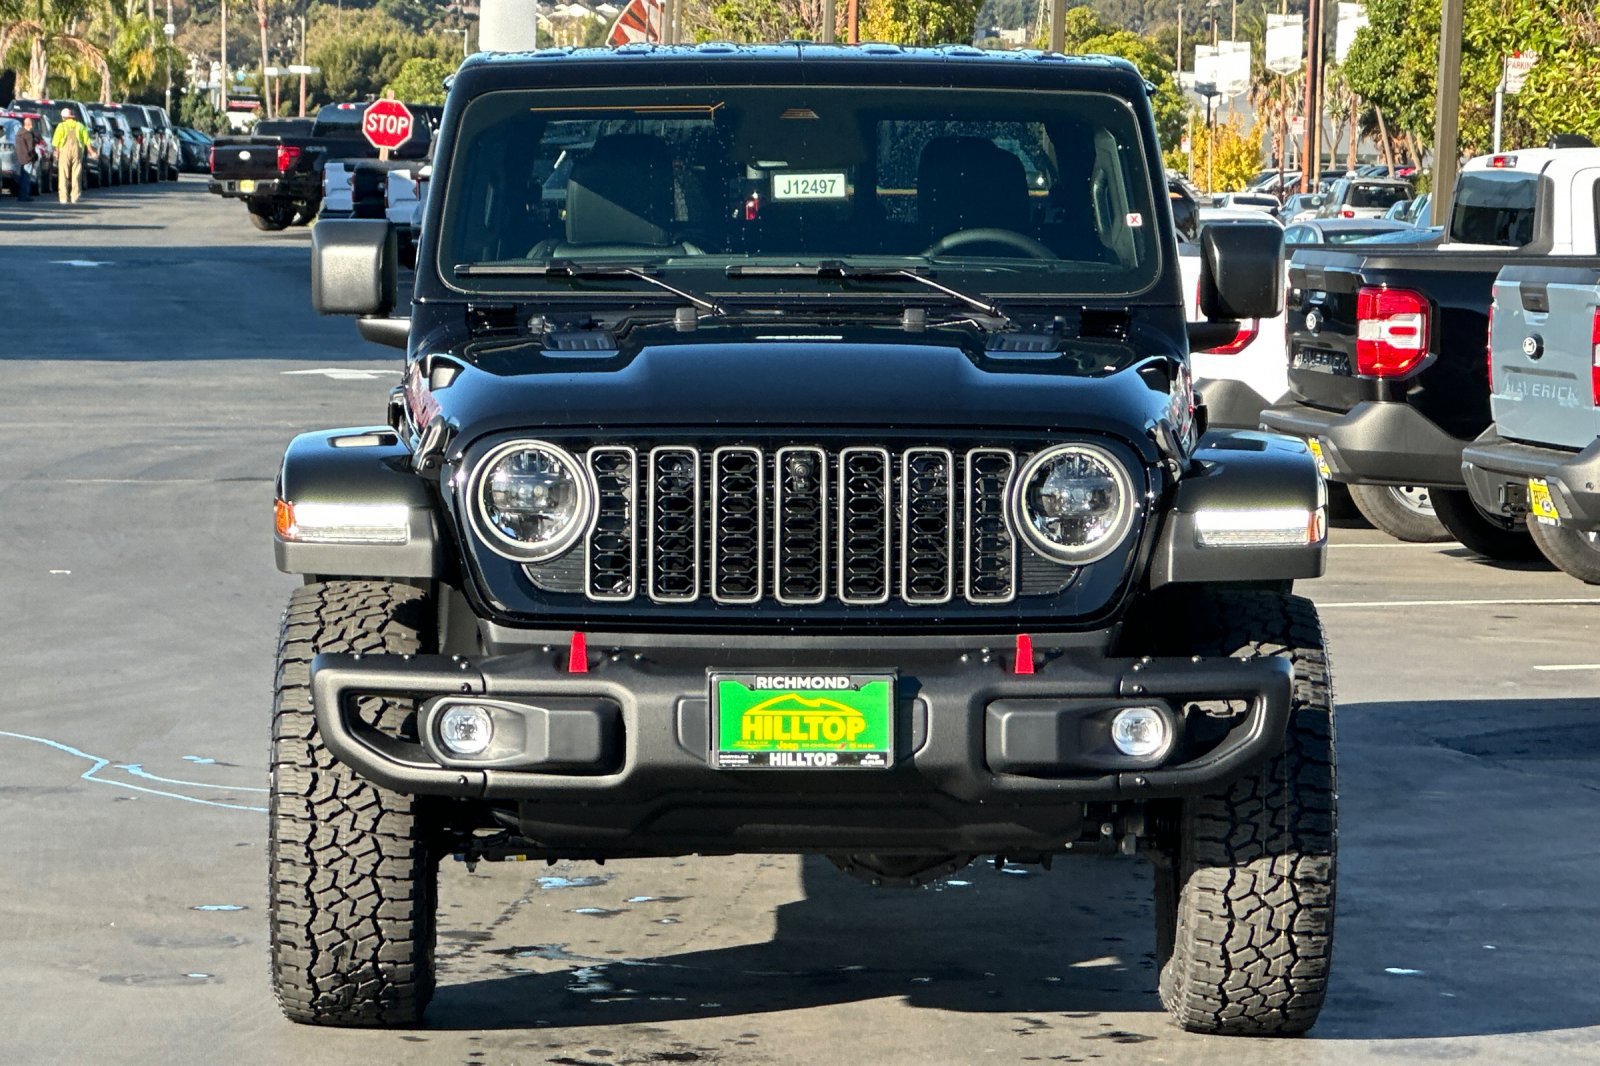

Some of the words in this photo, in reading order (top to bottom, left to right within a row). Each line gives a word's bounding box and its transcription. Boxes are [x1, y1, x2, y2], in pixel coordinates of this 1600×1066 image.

[1522, 50, 1536, 59] NO
[1506, 60, 1535, 70] PARKIN
[367, 112, 409, 135] STOP
[783, 179, 836, 195] J12497
[756, 676, 850, 690] RICHMOND
[741, 714, 867, 742] HILLTOP
[769, 752, 839, 767] HILLTOP
